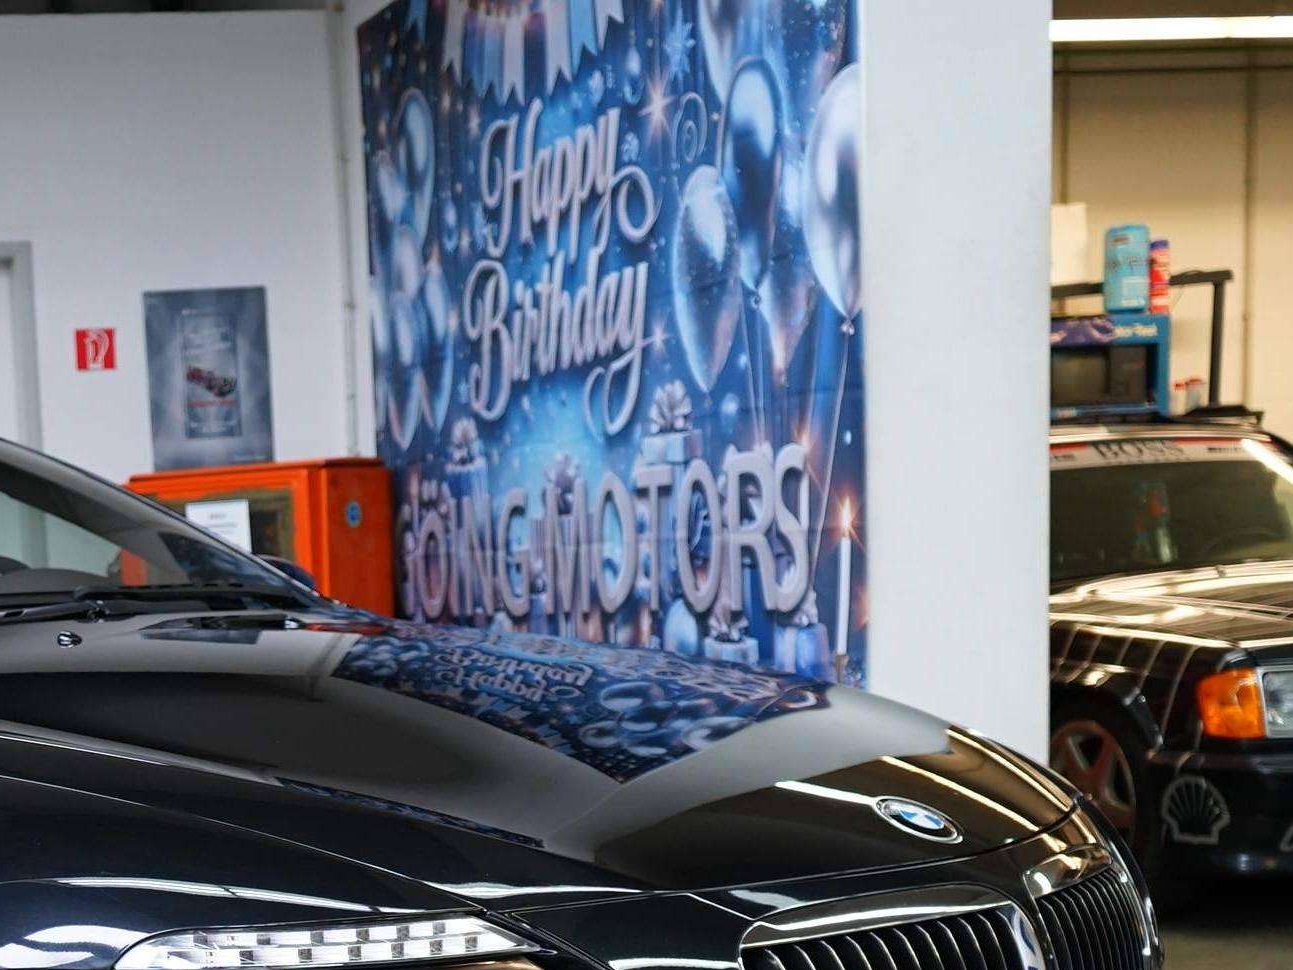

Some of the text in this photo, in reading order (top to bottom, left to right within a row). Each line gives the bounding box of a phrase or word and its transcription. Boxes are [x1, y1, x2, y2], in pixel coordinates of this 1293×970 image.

[480, 97, 656, 263] Happy
[464, 248, 650, 435] Birthday
[544, 441, 811, 617] MOTORS
